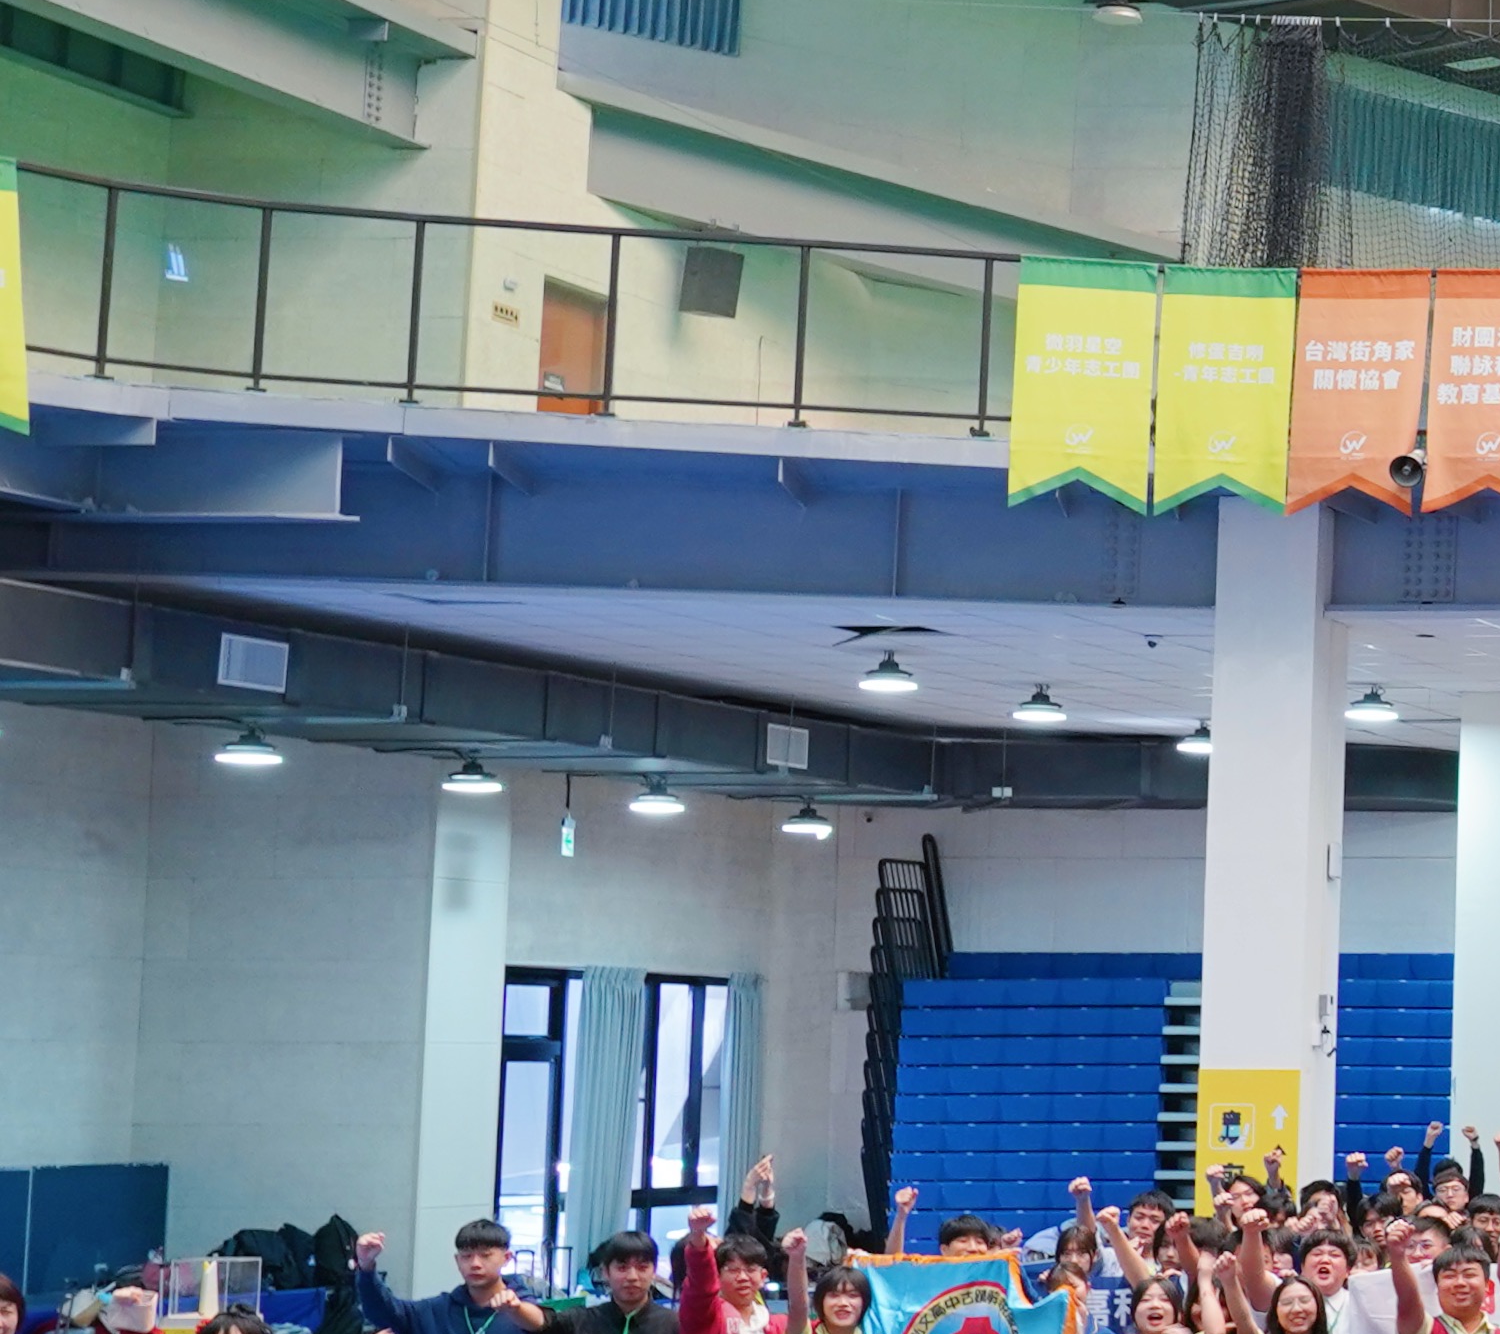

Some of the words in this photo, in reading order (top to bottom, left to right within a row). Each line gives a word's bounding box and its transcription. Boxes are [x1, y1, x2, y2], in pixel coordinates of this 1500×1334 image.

[1305, 340, 1415, 362] 台灣街角家
[1313, 368, 1401, 390] 關懷協會
